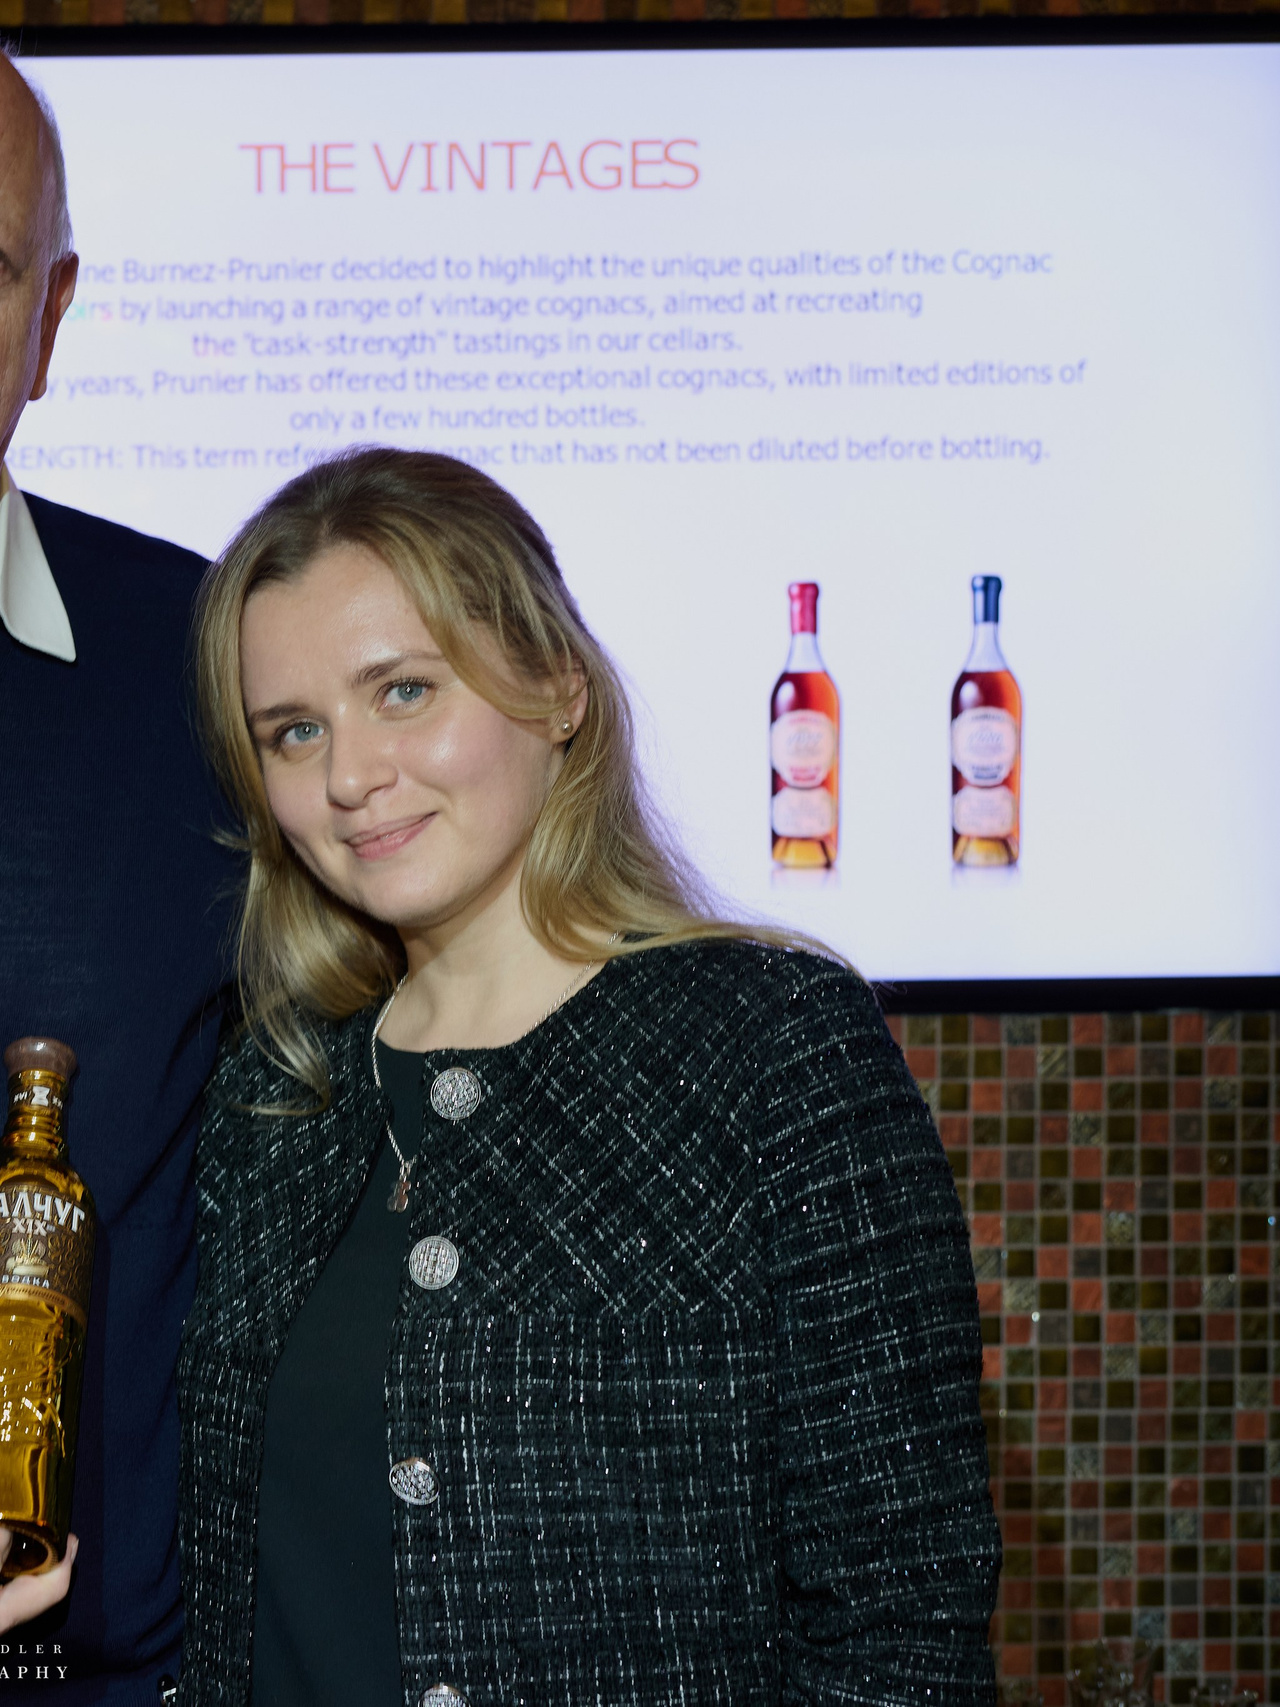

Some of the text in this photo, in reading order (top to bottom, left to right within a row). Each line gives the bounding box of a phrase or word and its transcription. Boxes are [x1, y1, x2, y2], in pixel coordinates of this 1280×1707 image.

[239, 138, 700, 193] THE VINTAGES
[122, 257, 325, 284] Burnez-Prunier
[330, 255, 437, 282] decided
[443, 256, 472, 280] to
[478, 254, 596, 285] highlight
[600, 254, 646, 278] the
[652, 252, 743, 284] unique
[748, 251, 862, 280] qualities
[867, 248, 896, 275] of
[901, 250, 946, 275] the
[951, 248, 1052, 280] Cognac
[66, 288, 923, 325] oirs by launching a range of vintage cognacs, aimed at recreating
[192, 333, 236, 357] the
[453, 331, 561, 359] tastings
[568, 329, 591, 352] in
[597, 332, 642, 352] our
[648, 327, 743, 352] cellars.
[65, 375, 144, 400] years,
[152, 370, 250, 395] Prunier
[255, 369, 302, 394] has
[309, 367, 407, 393] offered
[414, 368, 489, 391] these
[496, 364, 651, 394] exceptional
[656, 368, 776, 395] cognacs,
[785, 363, 842, 387] with
[849, 362, 940, 386] limited
[945, 360, 1054, 386] editions
[1058, 358, 1088, 385] of
[289, 403, 646, 436] only a few hundred bottles.
[6, 445, 123, 469] RENGTH:
[131, 443, 188, 469] This
[192, 445, 257, 469] term
[511, 441, 565, 464] that
[572, 440, 619, 464] has
[626, 438, 668, 463] not
[676, 440, 741, 463] been
[747, 436, 839, 462] diluted
[846, 435, 934, 461] before
[940, 435, 1049, 465] bottling.
[12, 1217, 48, 1236] XIX
[2, 1274, 50, 1289] ВОДКА
